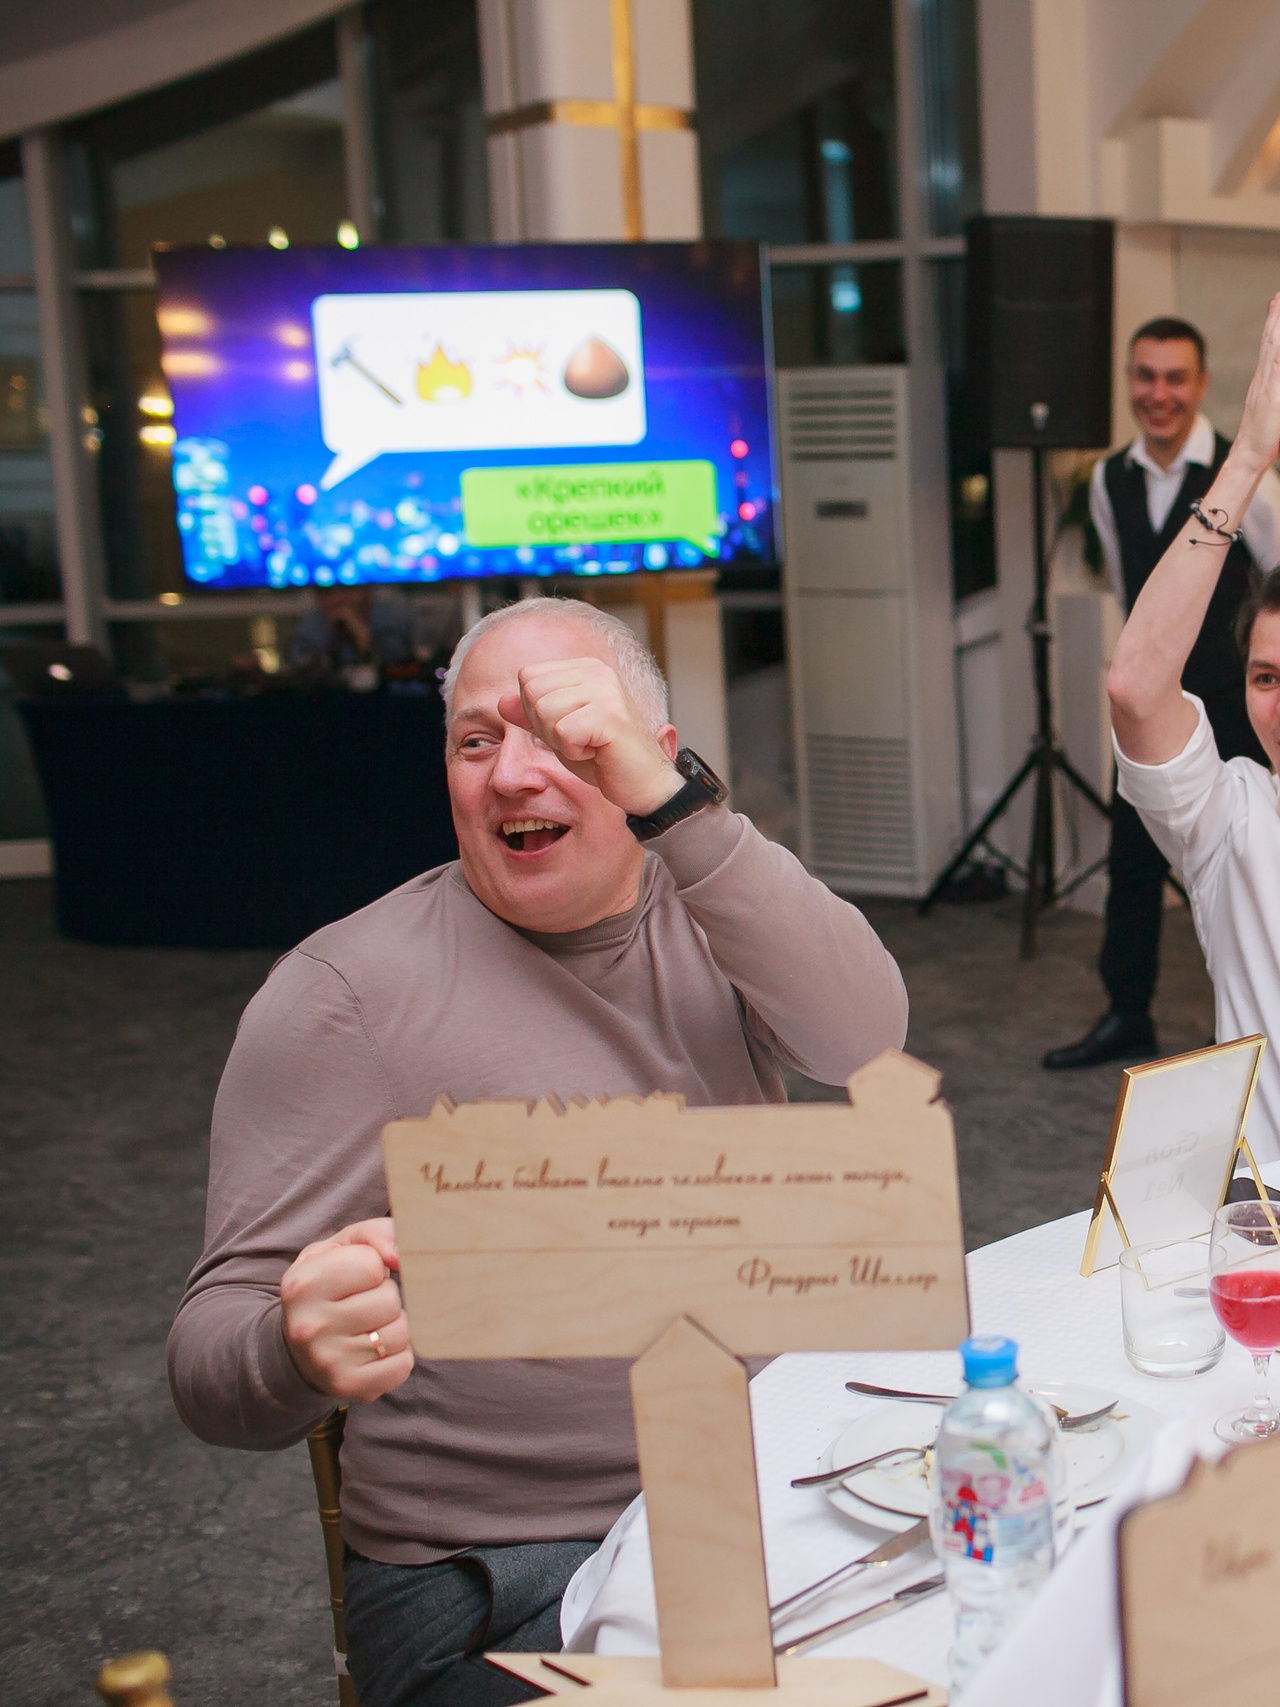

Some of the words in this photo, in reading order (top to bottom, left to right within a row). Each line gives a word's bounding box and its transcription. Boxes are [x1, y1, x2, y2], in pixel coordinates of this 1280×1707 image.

[515, 471, 666, 503] «Крепкий
[527, 509, 663, 535] орешек»
[420, 1159, 503, 1193] Человек
[513, 1157, 588, 1189] бывает
[597, 1155, 664, 1189] вполне
[673, 1153, 773, 1185] человеком
[608, 1217, 661, 1238] когда
[669, 1216, 741, 1237] играет
[736, 1256, 839, 1295] Фридрих
[850, 1254, 939, 1293] Шиллер
